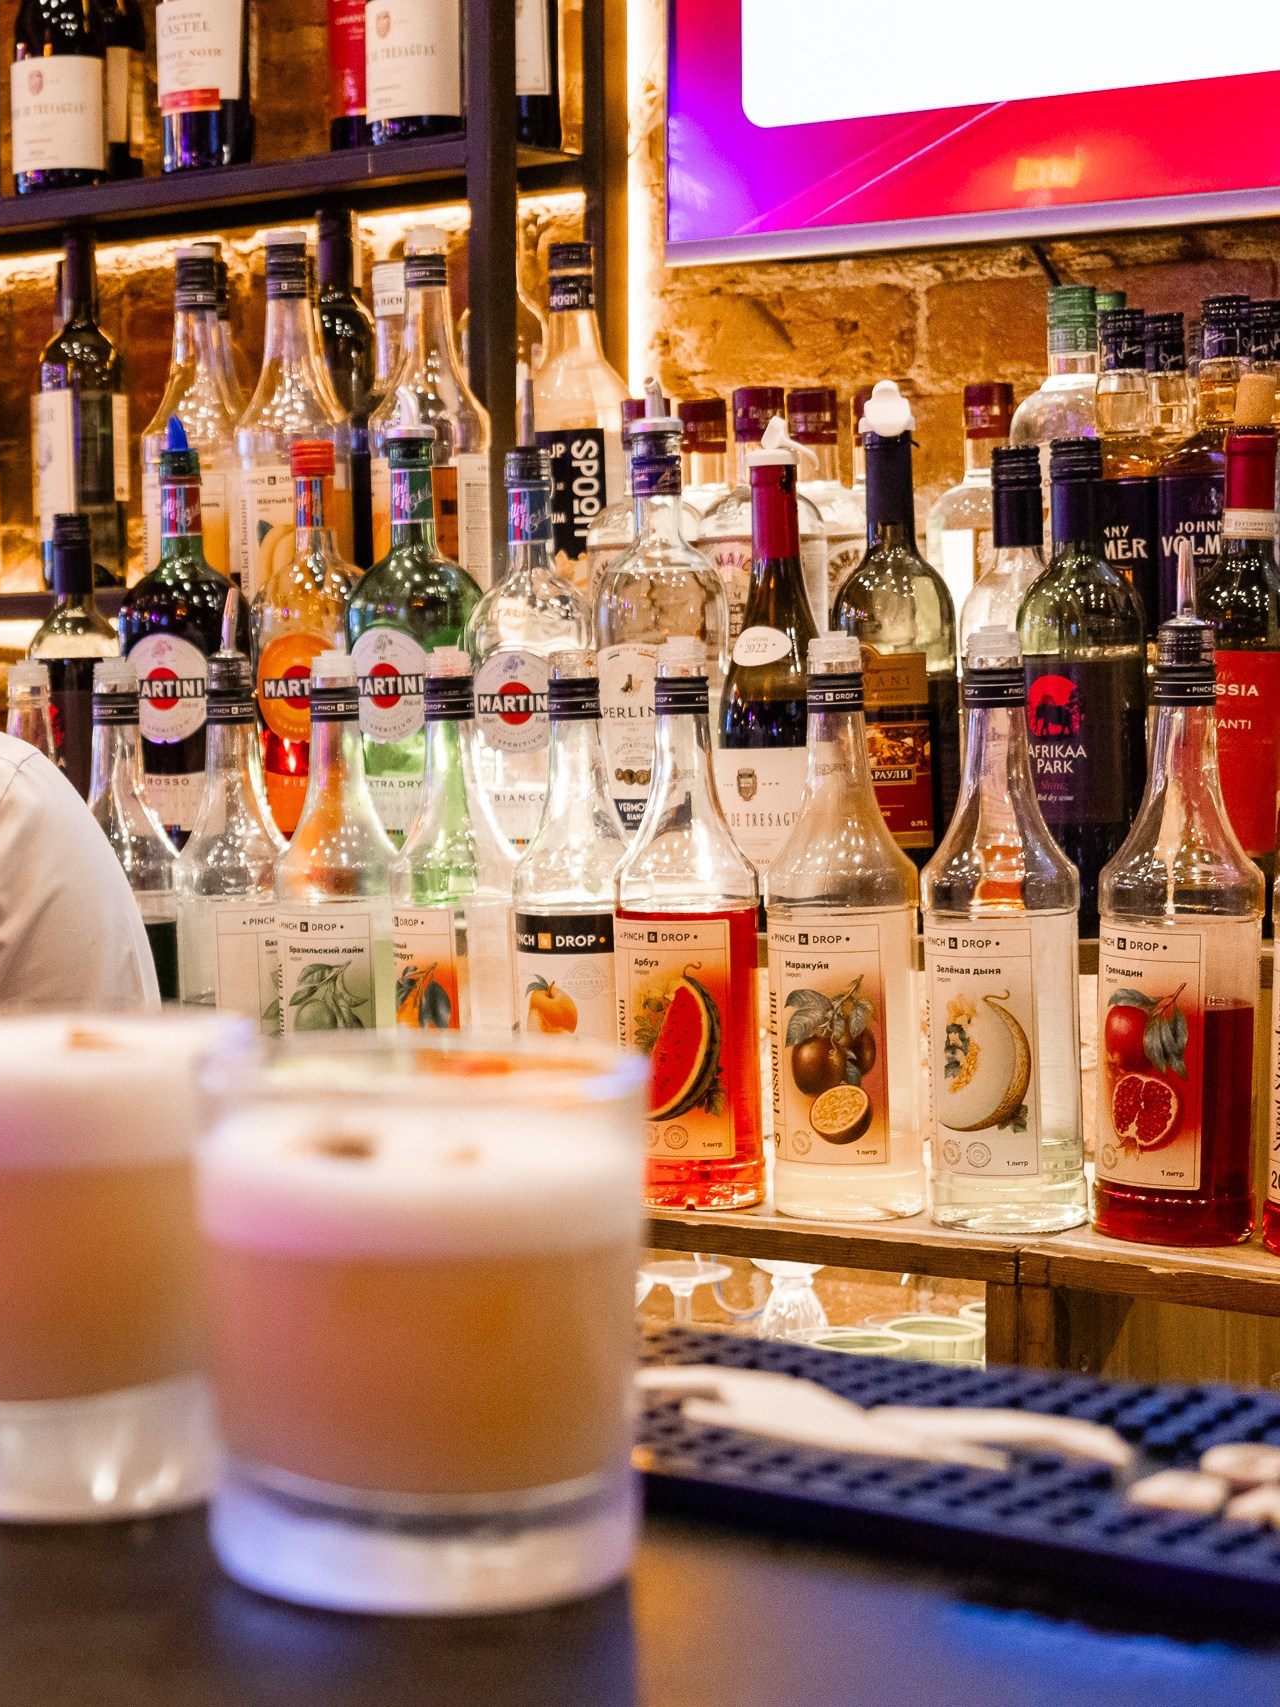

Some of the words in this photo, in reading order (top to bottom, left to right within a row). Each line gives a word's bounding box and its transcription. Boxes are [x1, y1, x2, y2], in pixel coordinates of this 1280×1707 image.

[1161, 534, 1221, 557] VOLM
[744, 643, 768, 654] 2022
[140, 679, 203, 698] ARTINI
[263, 679, 311, 698] MART
[1215, 683, 1260, 697] SSIA
[835, 691, 855, 700] DROP
[479, 694, 548, 713] MARTIN
[603, 707, 656, 719] PERLIN
[1216, 719, 1252, 730] ANTI
[1028, 744, 1088, 758] AFRIKAA
[1037, 759, 1074, 774] PARK
[147, 777, 190, 787] ROSSO
[282, 779, 307, 788] FIE
[368, 779, 395, 789] XTRA
[398, 779, 423, 788] DRY
[248, 917, 276, 926] PINCH
[311, 923, 337, 931] DROP
[399, 918, 419, 927] DROP
[554, 935, 597, 948] DROP
[623, 932, 645, 941] PINCH
[661, 933, 691, 942] DROP
[774, 933, 796, 943] PINCH
[812, 935, 843, 944] DROP
[961, 939, 992, 949] DROP
[1129, 940, 1160, 952] DROP
[288, 945, 340, 955] Бразильский
[341, 946, 365, 954] лайм
[633, 957, 660, 968] Арбуз
[784, 959, 830, 970] Маракуйя
[936, 964, 971, 975] Зелёная
[972, 966, 1002, 976] дыня
[1105, 964, 1144, 979] Гренадин
[1010, 1160, 1029, 1168] литр
[1165, 1170, 1185, 1178] литр
